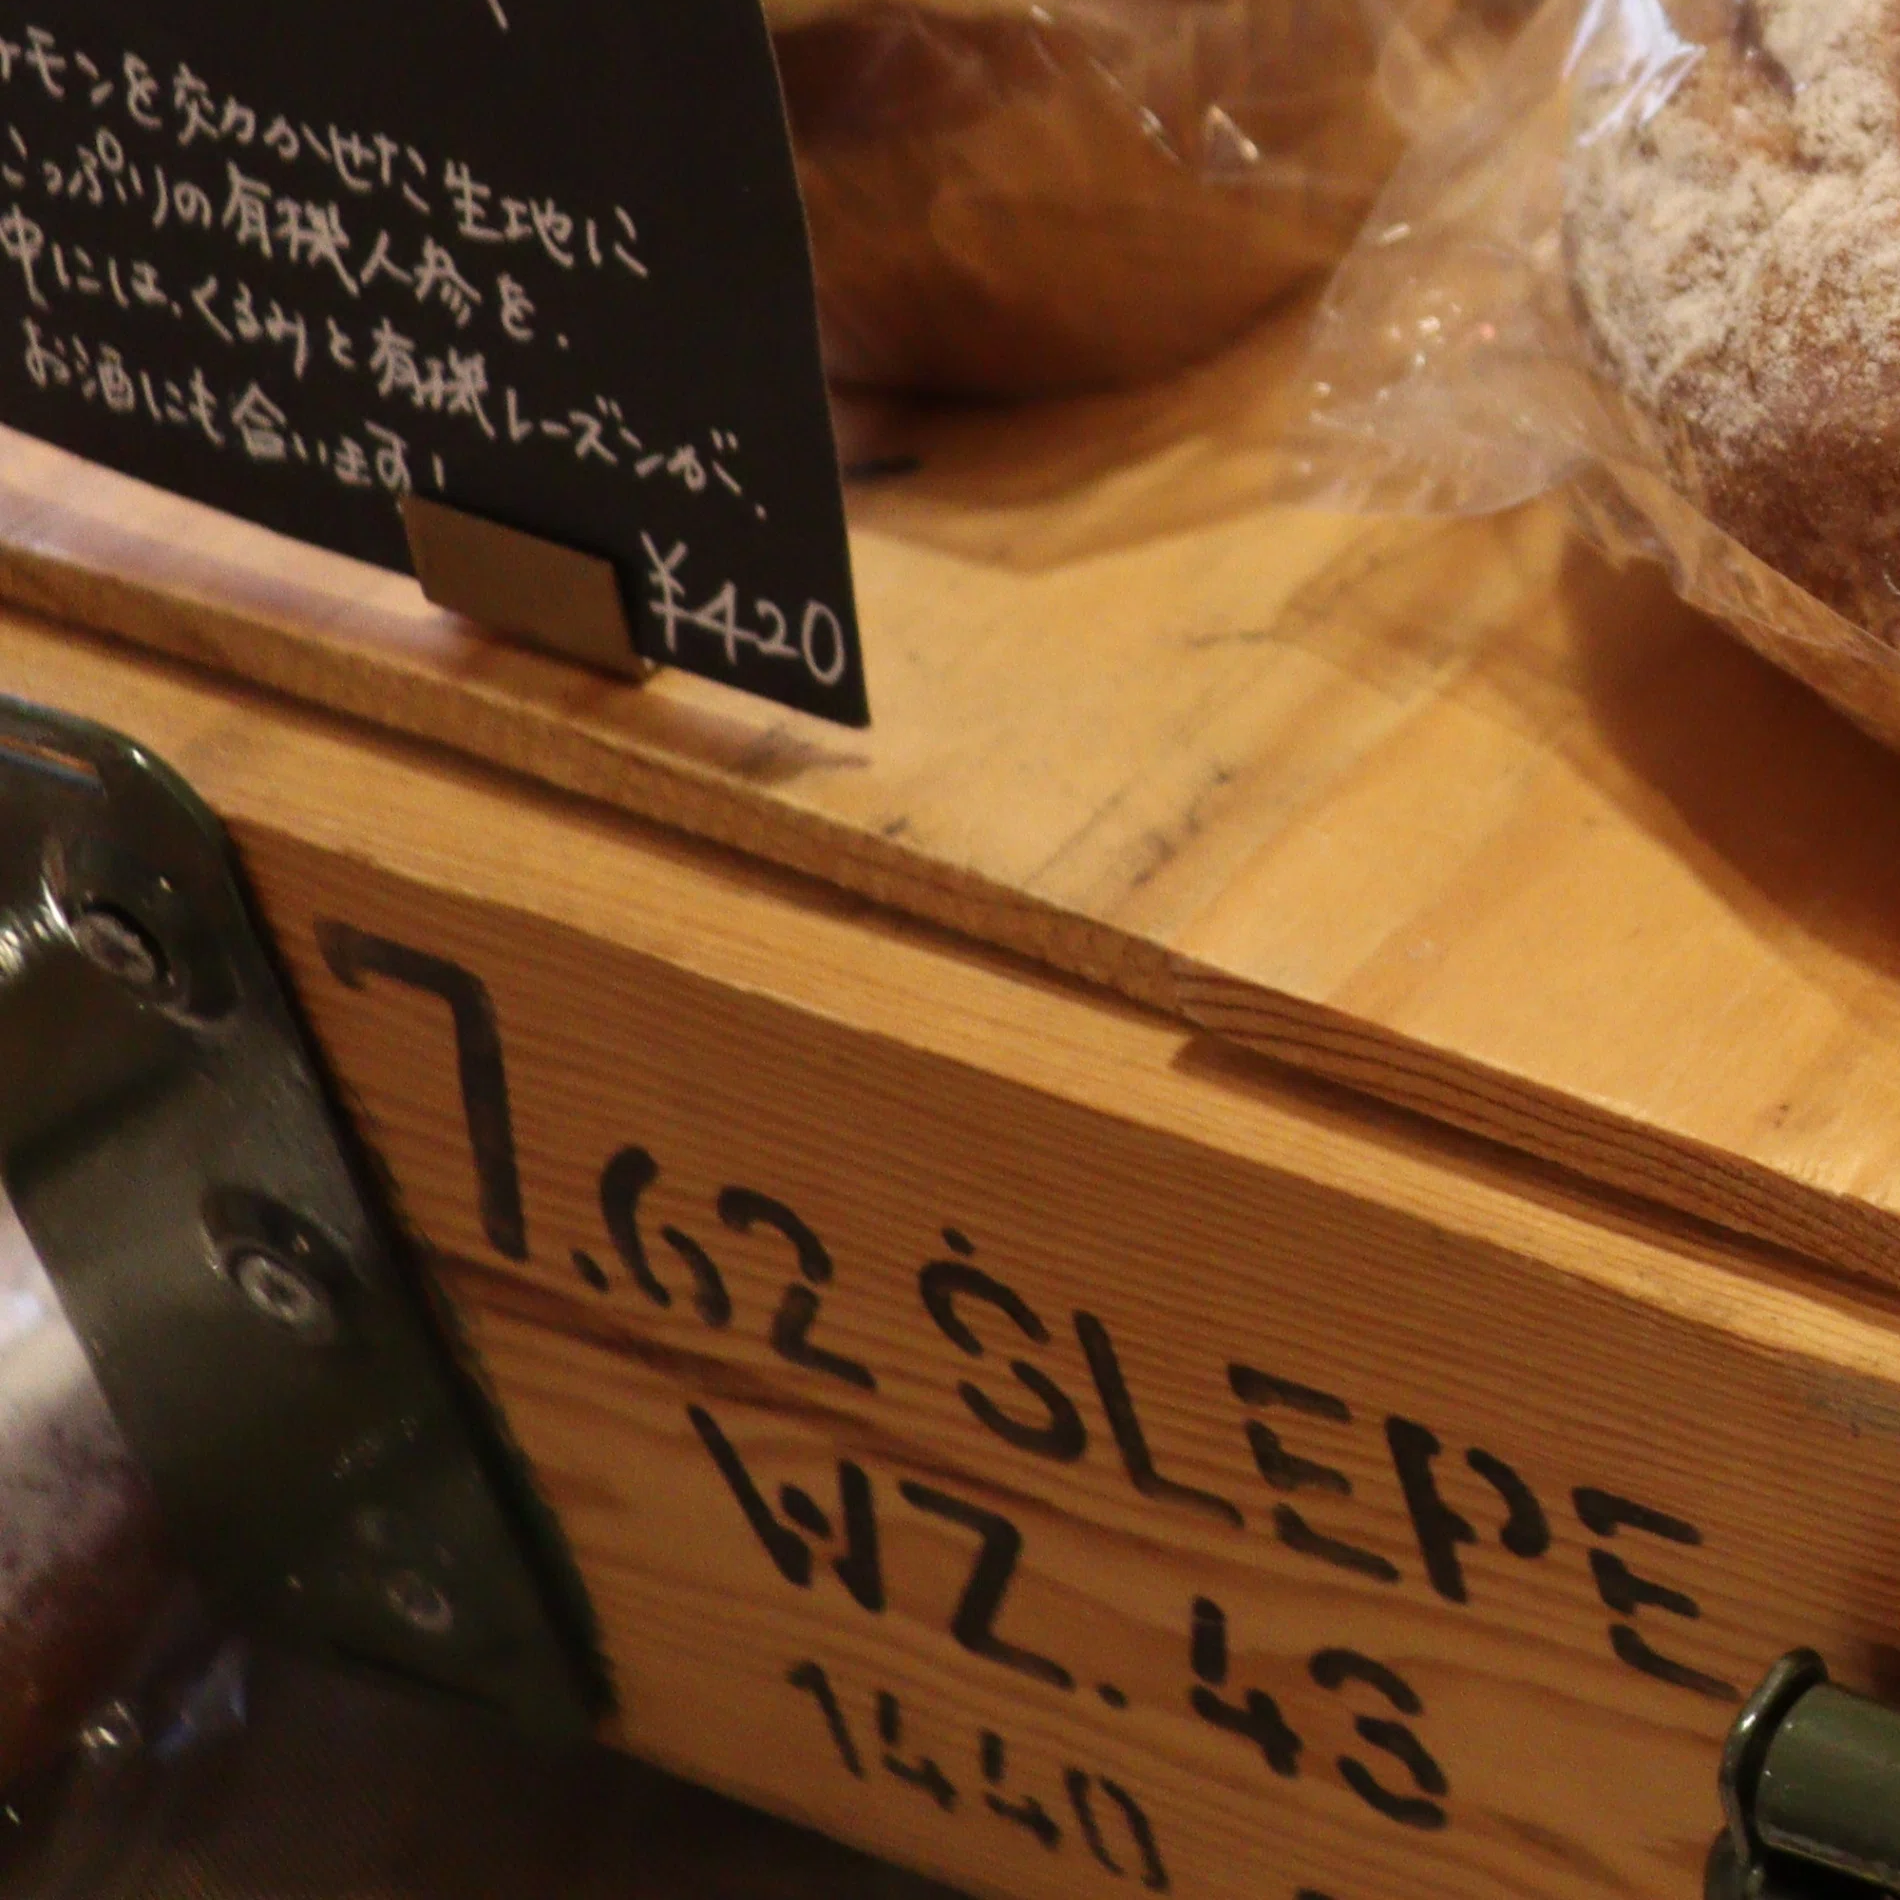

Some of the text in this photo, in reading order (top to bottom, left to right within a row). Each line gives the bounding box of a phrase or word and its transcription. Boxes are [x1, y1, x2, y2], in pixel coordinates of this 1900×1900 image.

[639, 530, 847, 688] ¥420
[313, 916, 877, 1392] 7.62
[785, 1660, 1171, 1893] 1440
